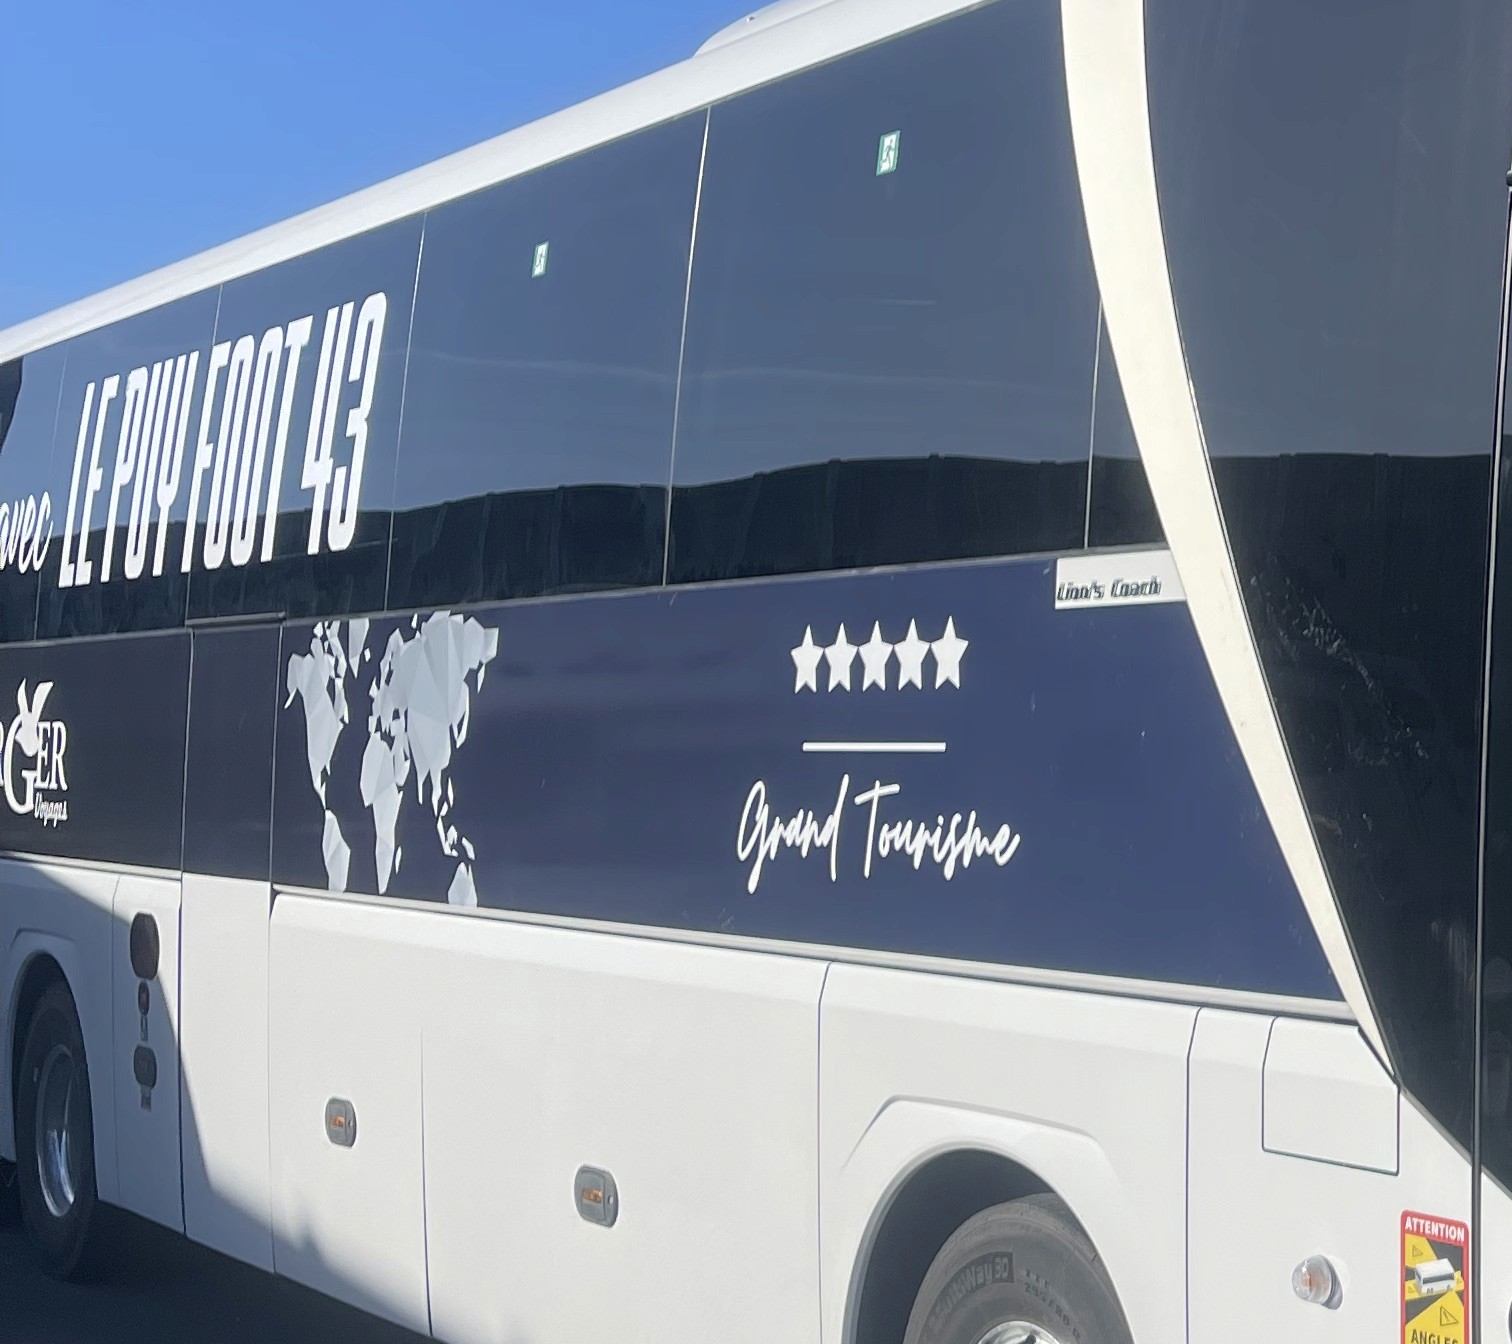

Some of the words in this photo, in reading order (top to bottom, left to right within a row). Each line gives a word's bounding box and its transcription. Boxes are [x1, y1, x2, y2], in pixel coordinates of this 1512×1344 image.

[58, 375, 120, 588] LE
[100, 351, 199, 583] PUY
[181, 315, 313, 573] FOOT
[301, 291, 387, 555] 43
[0, 712, 69, 815] GER
[736, 773, 850, 894] Grand
[854, 780, 1020, 881] Tourisme
[1404, 1216, 1465, 1243] ATTENTION
